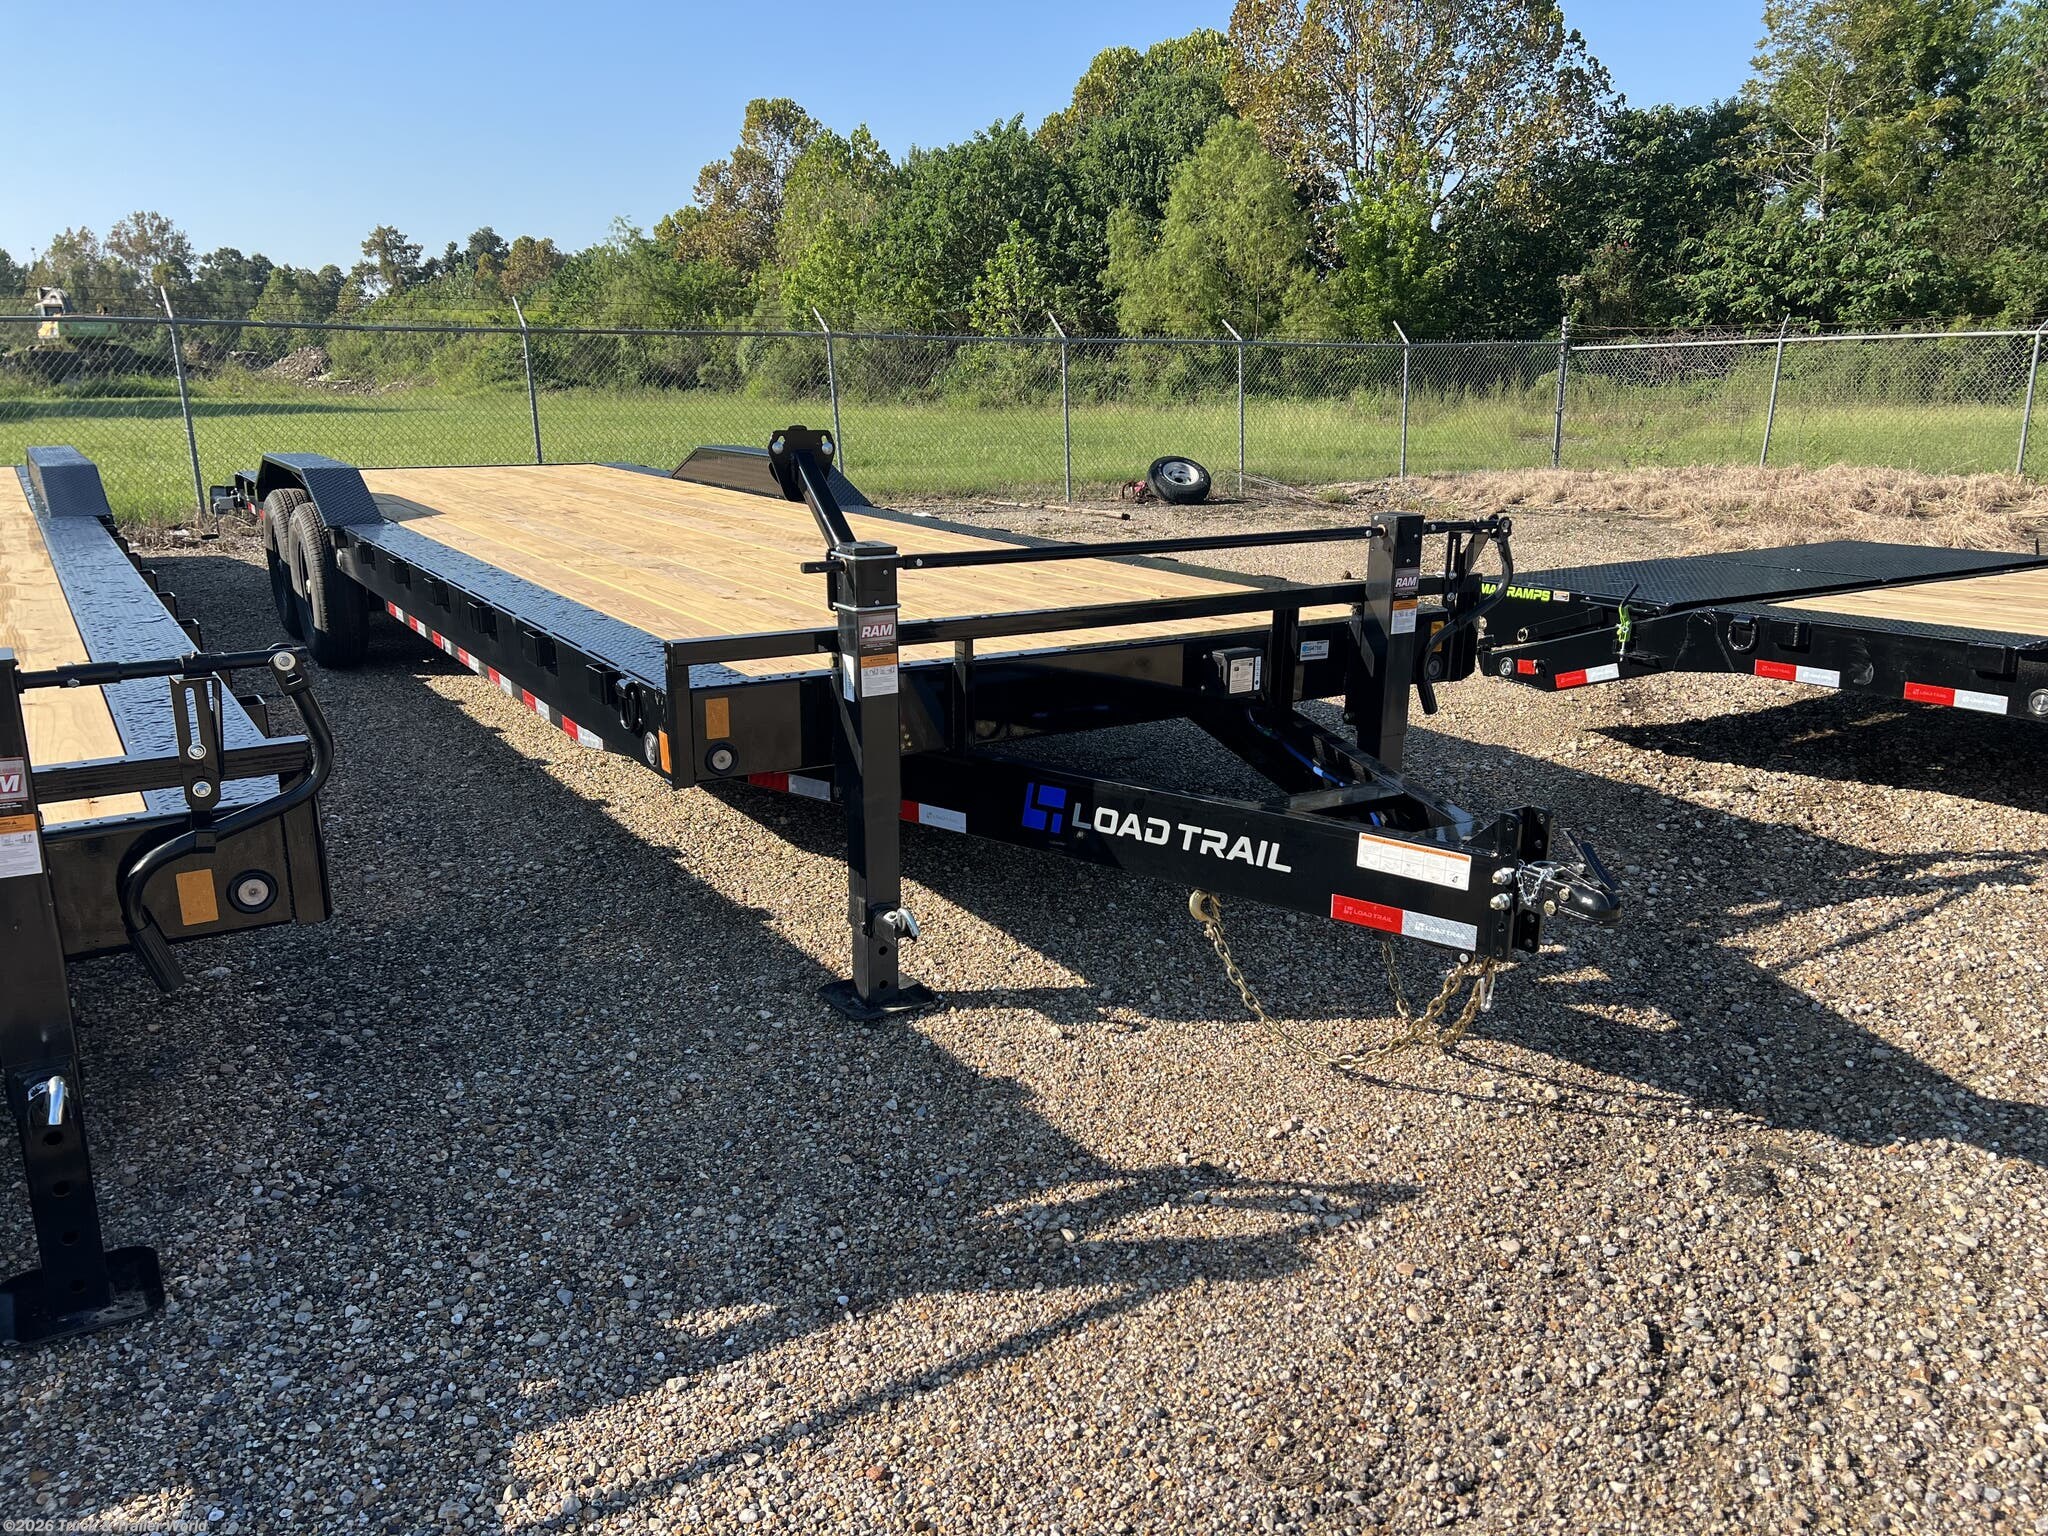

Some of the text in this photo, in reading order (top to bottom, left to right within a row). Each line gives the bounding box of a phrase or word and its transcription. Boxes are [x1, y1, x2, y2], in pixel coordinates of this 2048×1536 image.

[1395, 577, 1417, 588] RAM
[1481, 583, 1499, 594] MA
[1506, 586, 1551, 601] RAMPS
[861, 623, 893, 638] RAM
[1072, 802, 1292, 873] LOAD TRAIL
[1353, 909, 1392, 923] LOAD TRAIL
